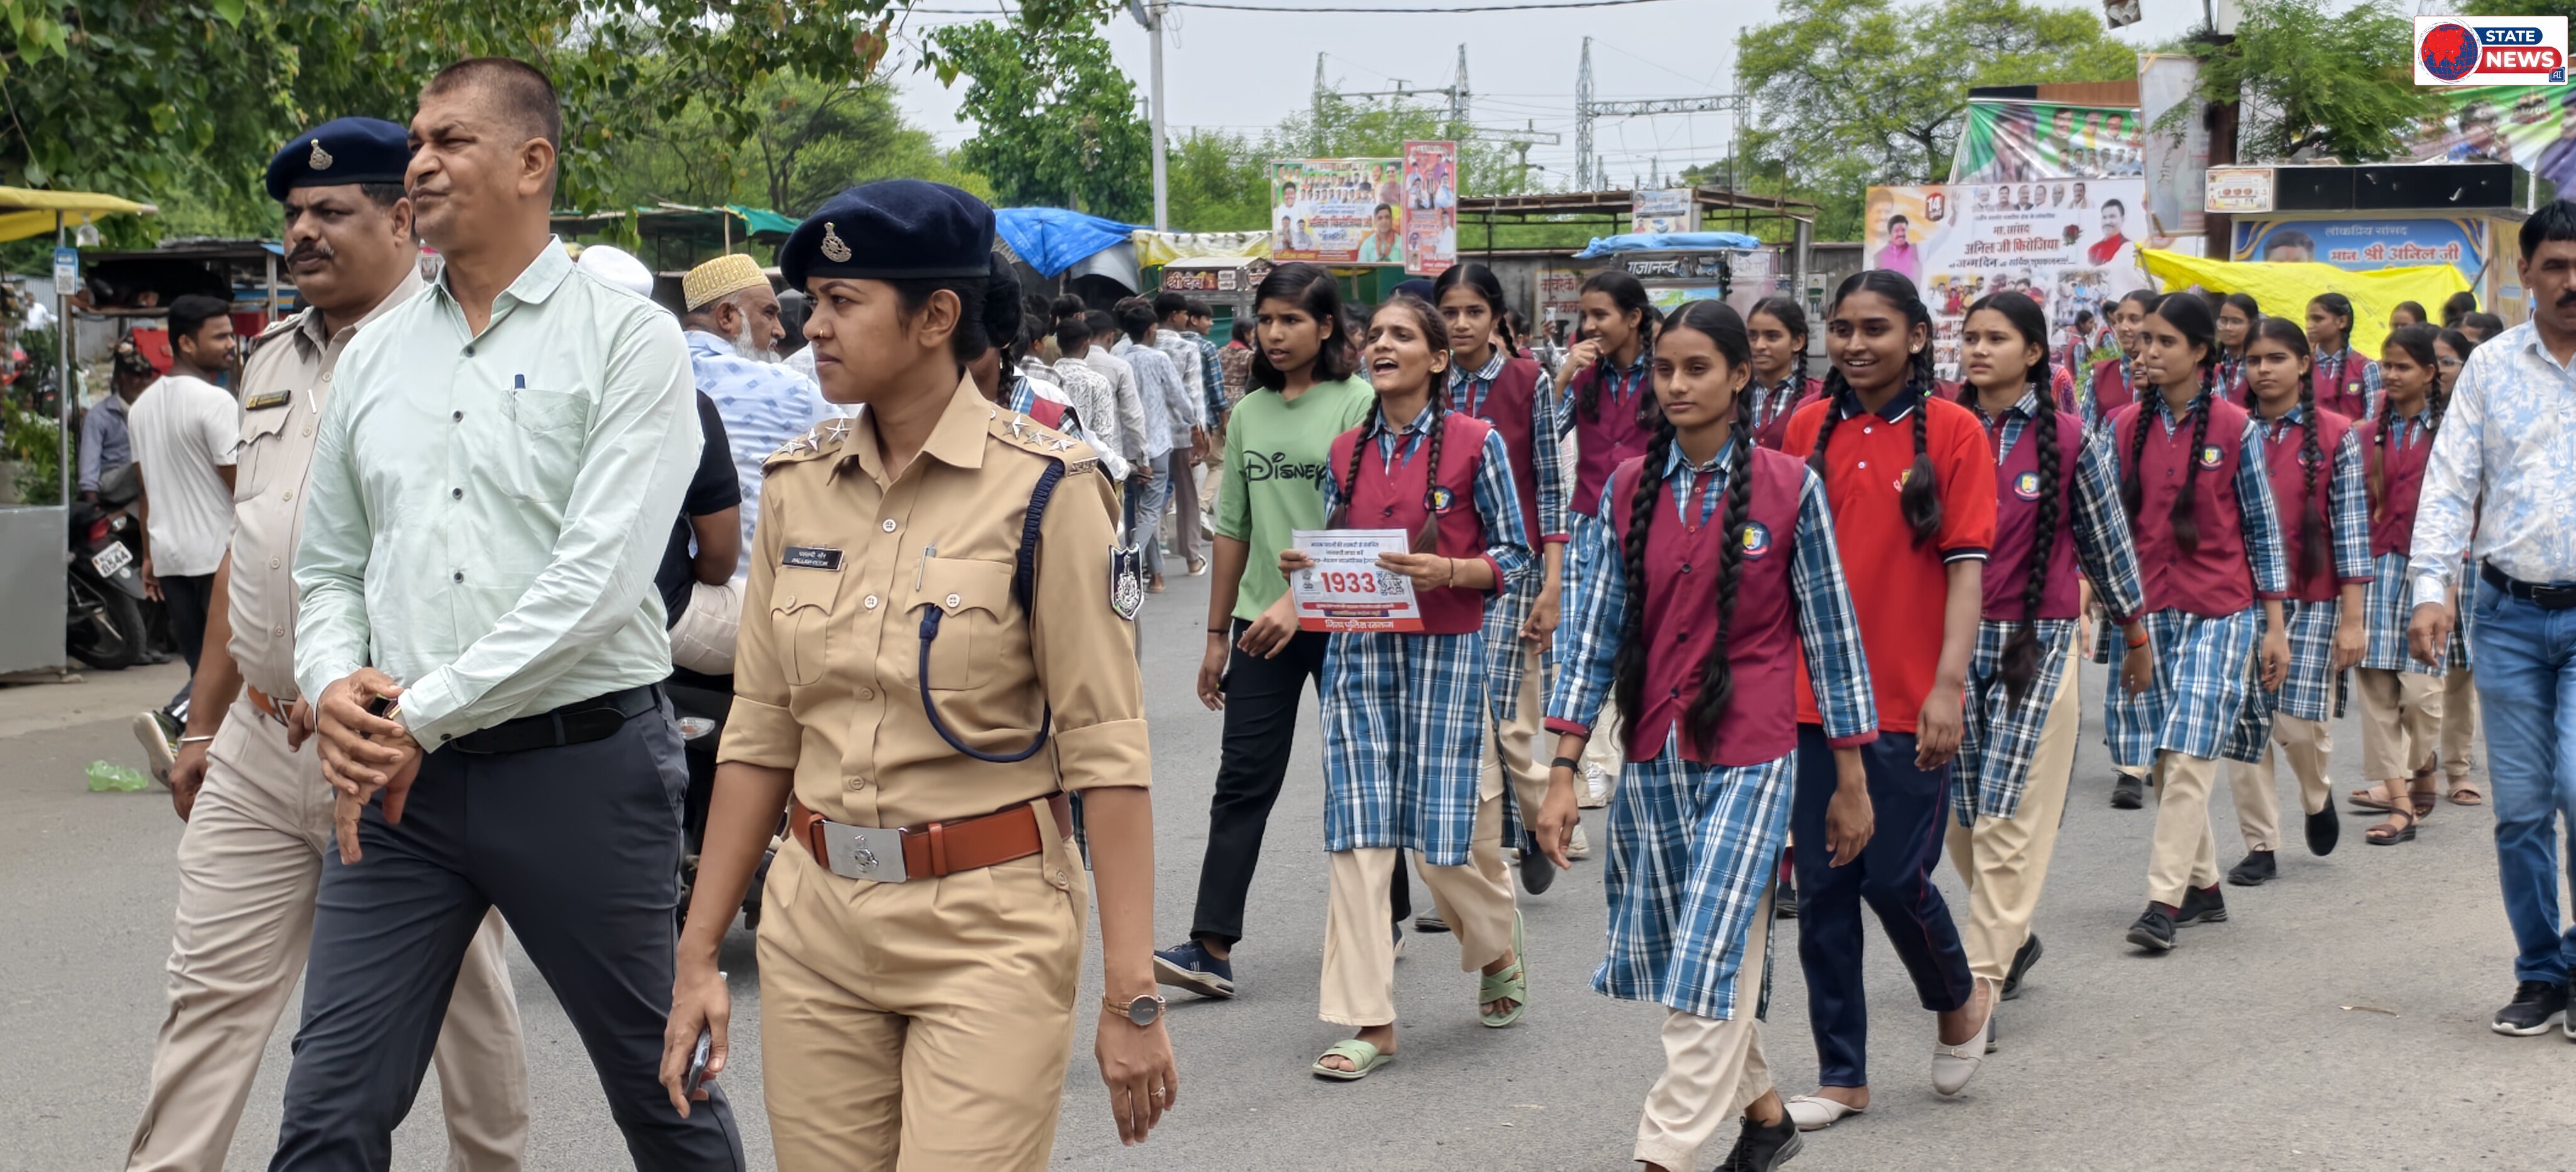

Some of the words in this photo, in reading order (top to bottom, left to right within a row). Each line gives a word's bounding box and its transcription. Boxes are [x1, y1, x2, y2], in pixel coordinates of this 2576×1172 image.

[2375, 226, 2408, 236] सांसद
[1964, 240, 1994, 255] अनिल
[1996, 238, 2011, 253] जी
[2365, 243, 2384, 261] श्री
[2389, 241, 2436, 261] अनिल
[2440, 241, 2459, 261] जी
[1627, 260, 1679, 275] गजानन्द
[1321, 572, 1376, 593] 1933
